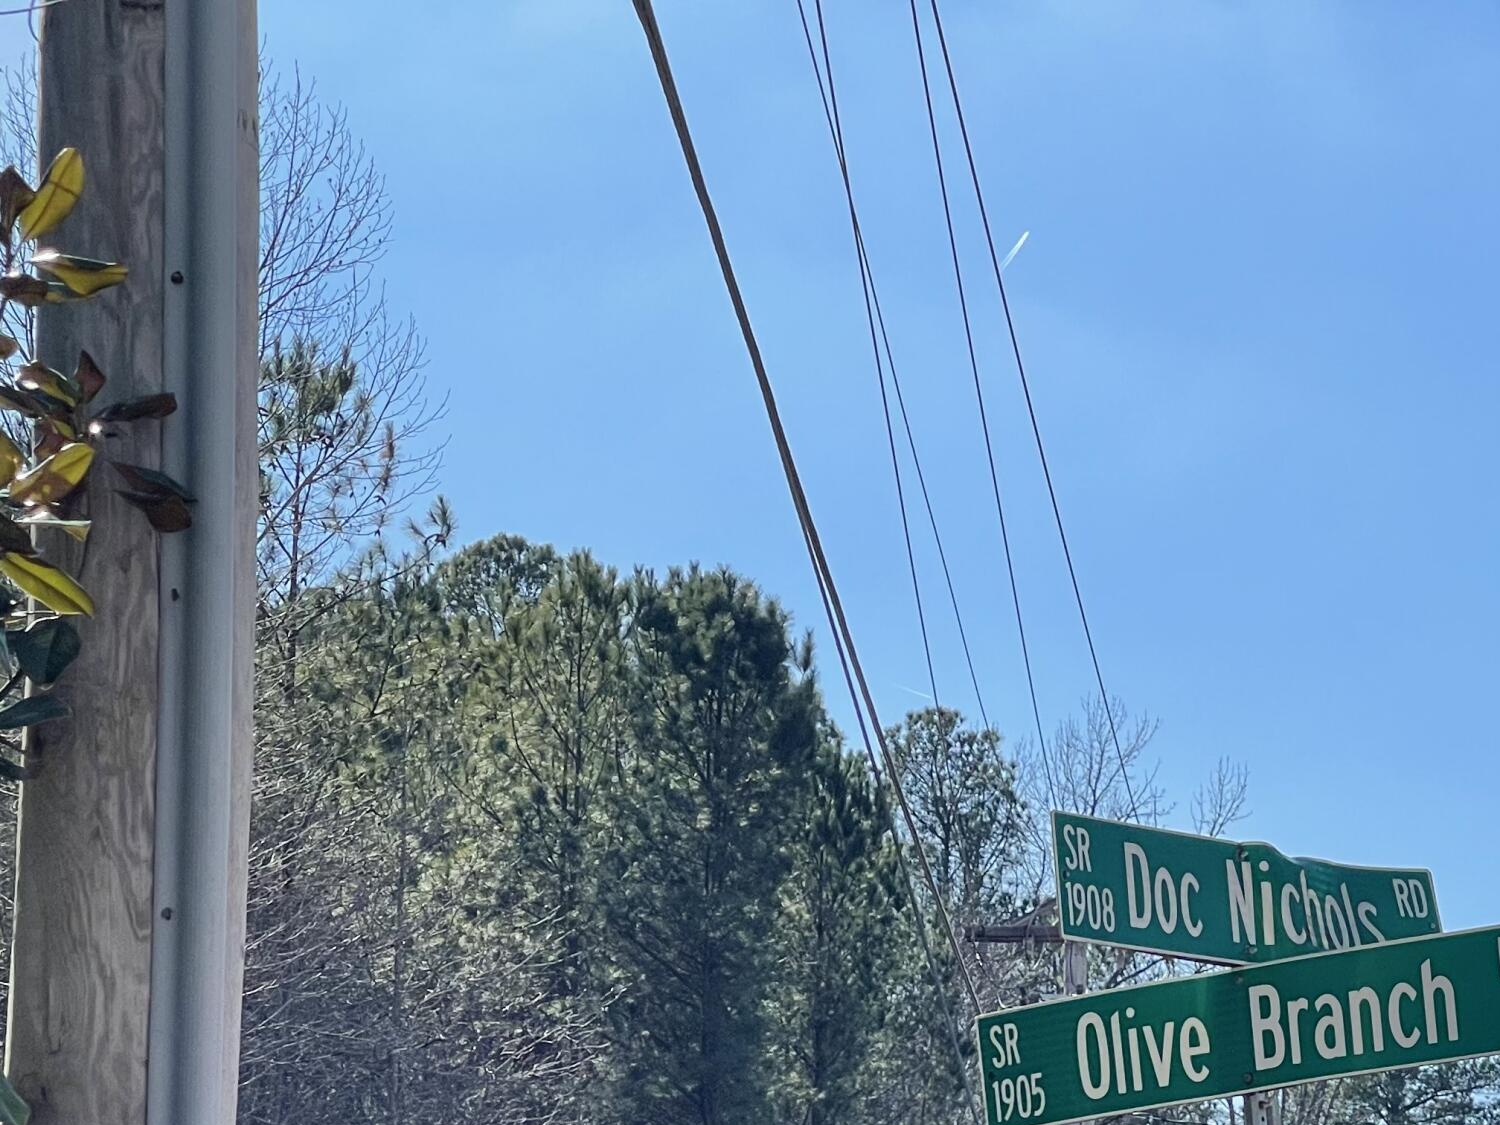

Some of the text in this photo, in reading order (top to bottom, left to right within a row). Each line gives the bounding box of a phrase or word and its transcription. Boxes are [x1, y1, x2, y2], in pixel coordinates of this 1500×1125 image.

[1063, 824, 1092, 872] SR
[1065, 881, 1116, 933] 1908
[1124, 841, 1429, 950] Doc Nichols RD
[990, 1023, 1021, 1069] SR
[1076, 1007, 1211, 1100] Olive
[1248, 958, 1459, 1071] Branch
[992, 1072, 1046, 1123] 1905
